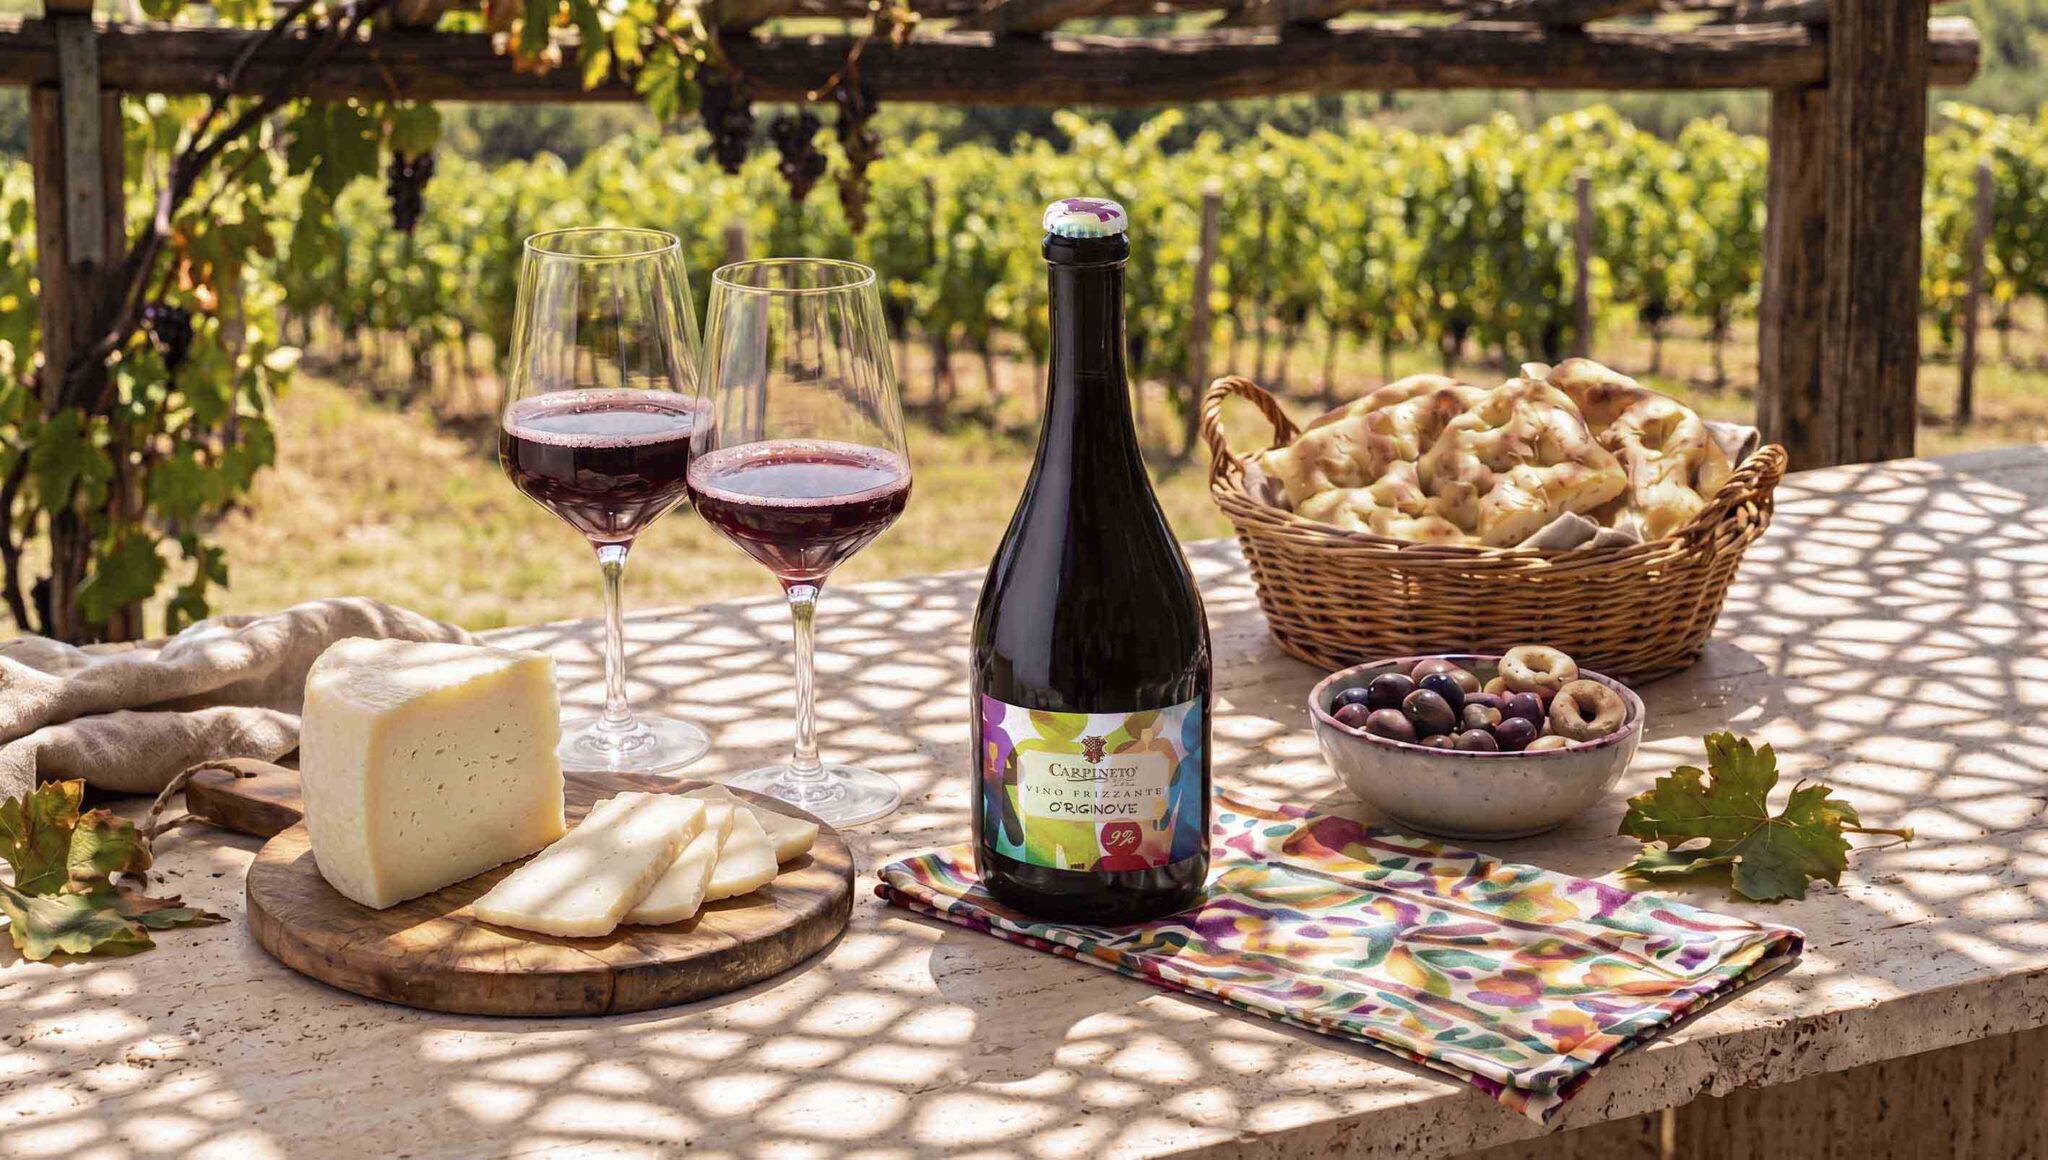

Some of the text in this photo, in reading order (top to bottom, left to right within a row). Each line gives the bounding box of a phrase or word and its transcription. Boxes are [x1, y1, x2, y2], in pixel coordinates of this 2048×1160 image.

[1049, 763, 1136, 778] CARPINETO
[1025, 785, 1162, 799] VINO FRIZZANTE
